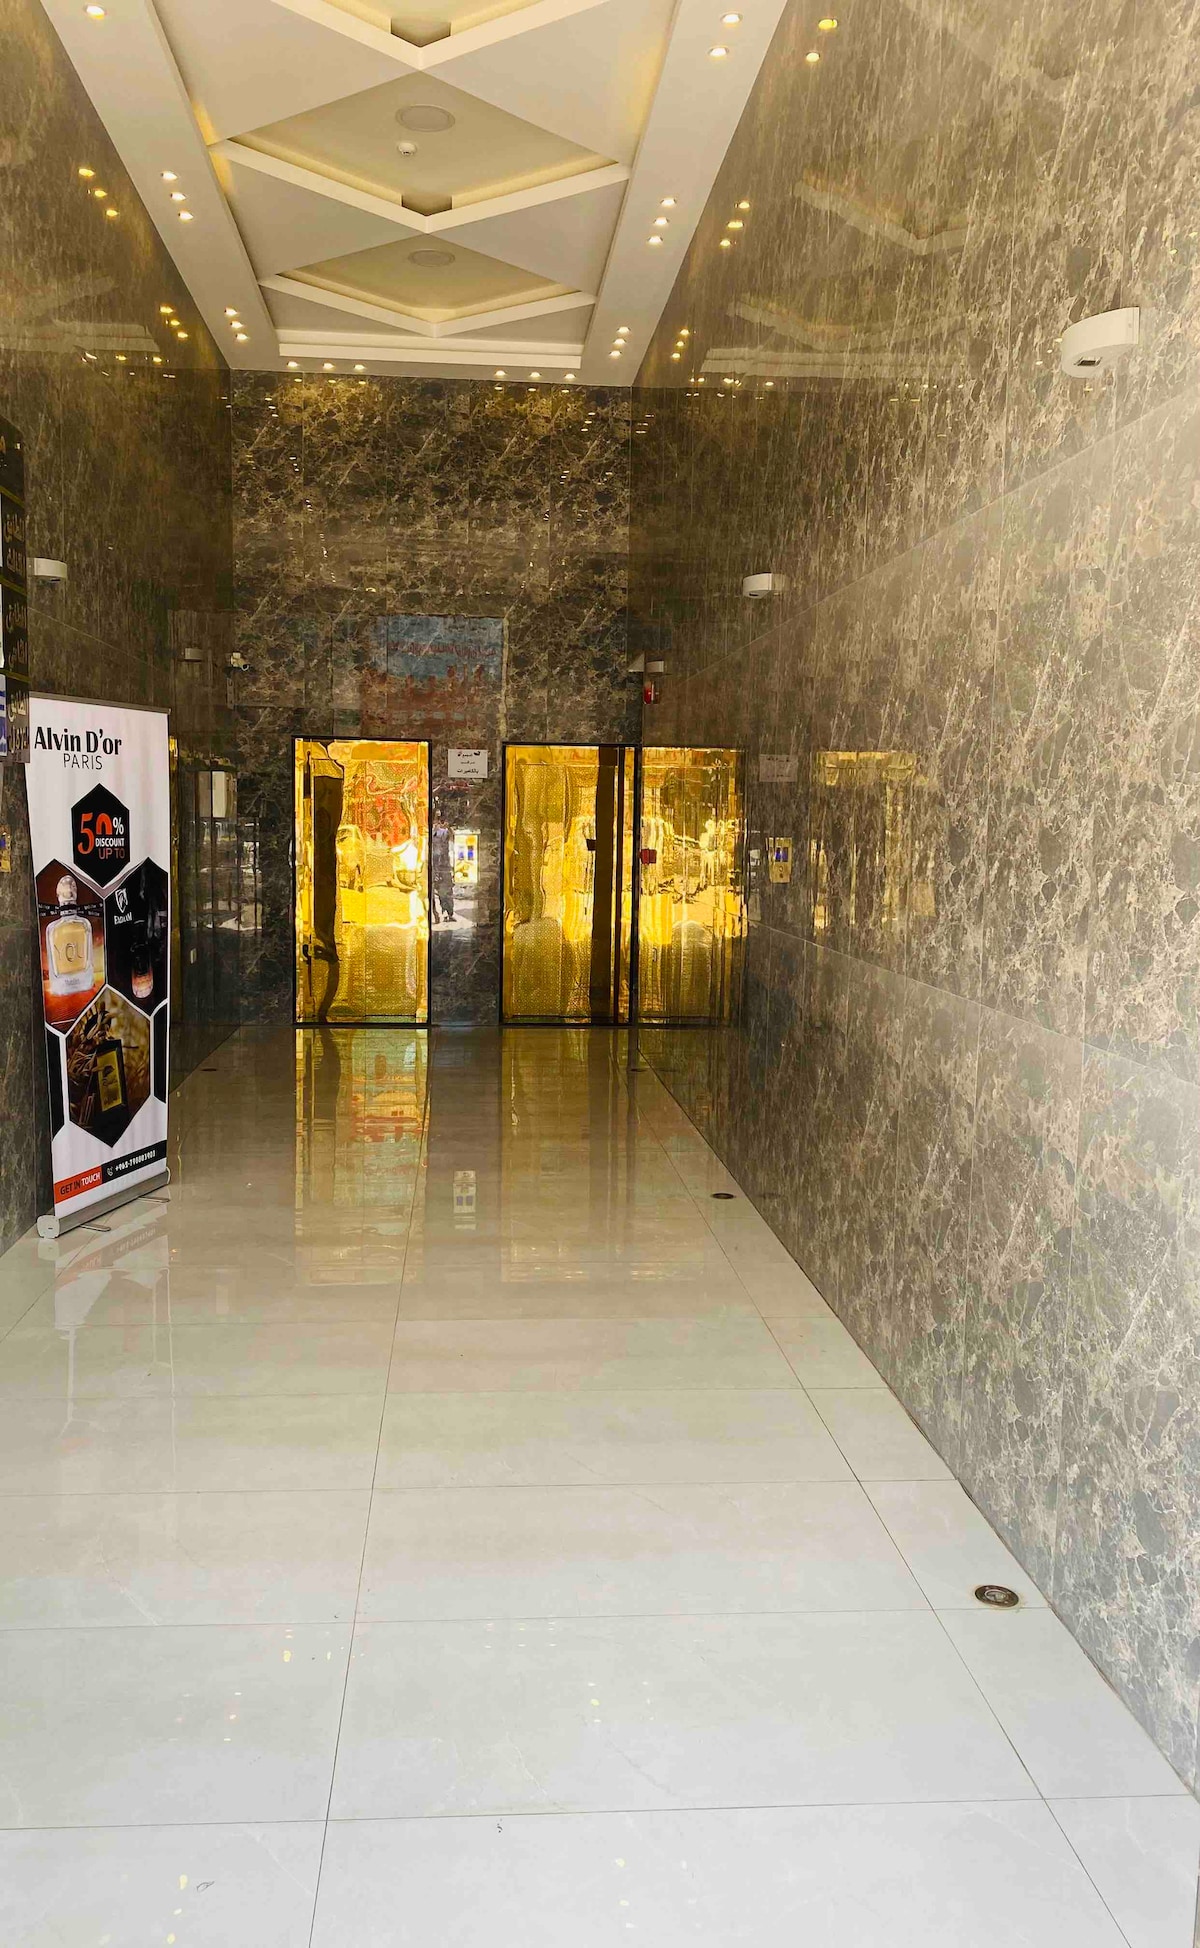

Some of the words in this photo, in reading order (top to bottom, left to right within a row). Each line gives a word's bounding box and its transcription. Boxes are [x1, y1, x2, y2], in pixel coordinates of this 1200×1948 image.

[34, 726, 81, 752] Alvin
[86, 728, 122, 755] D'or
[63, 753, 103, 770] PARIS
[95, 837, 125, 847] DISCOUNT
[98, 848, 113, 860] UP
[114, 848, 125, 859] TO
[60, 1183, 73, 1195] GET
[73, 1180, 81, 1189] IN
[81, 1172, 101, 1186] TOUCH
